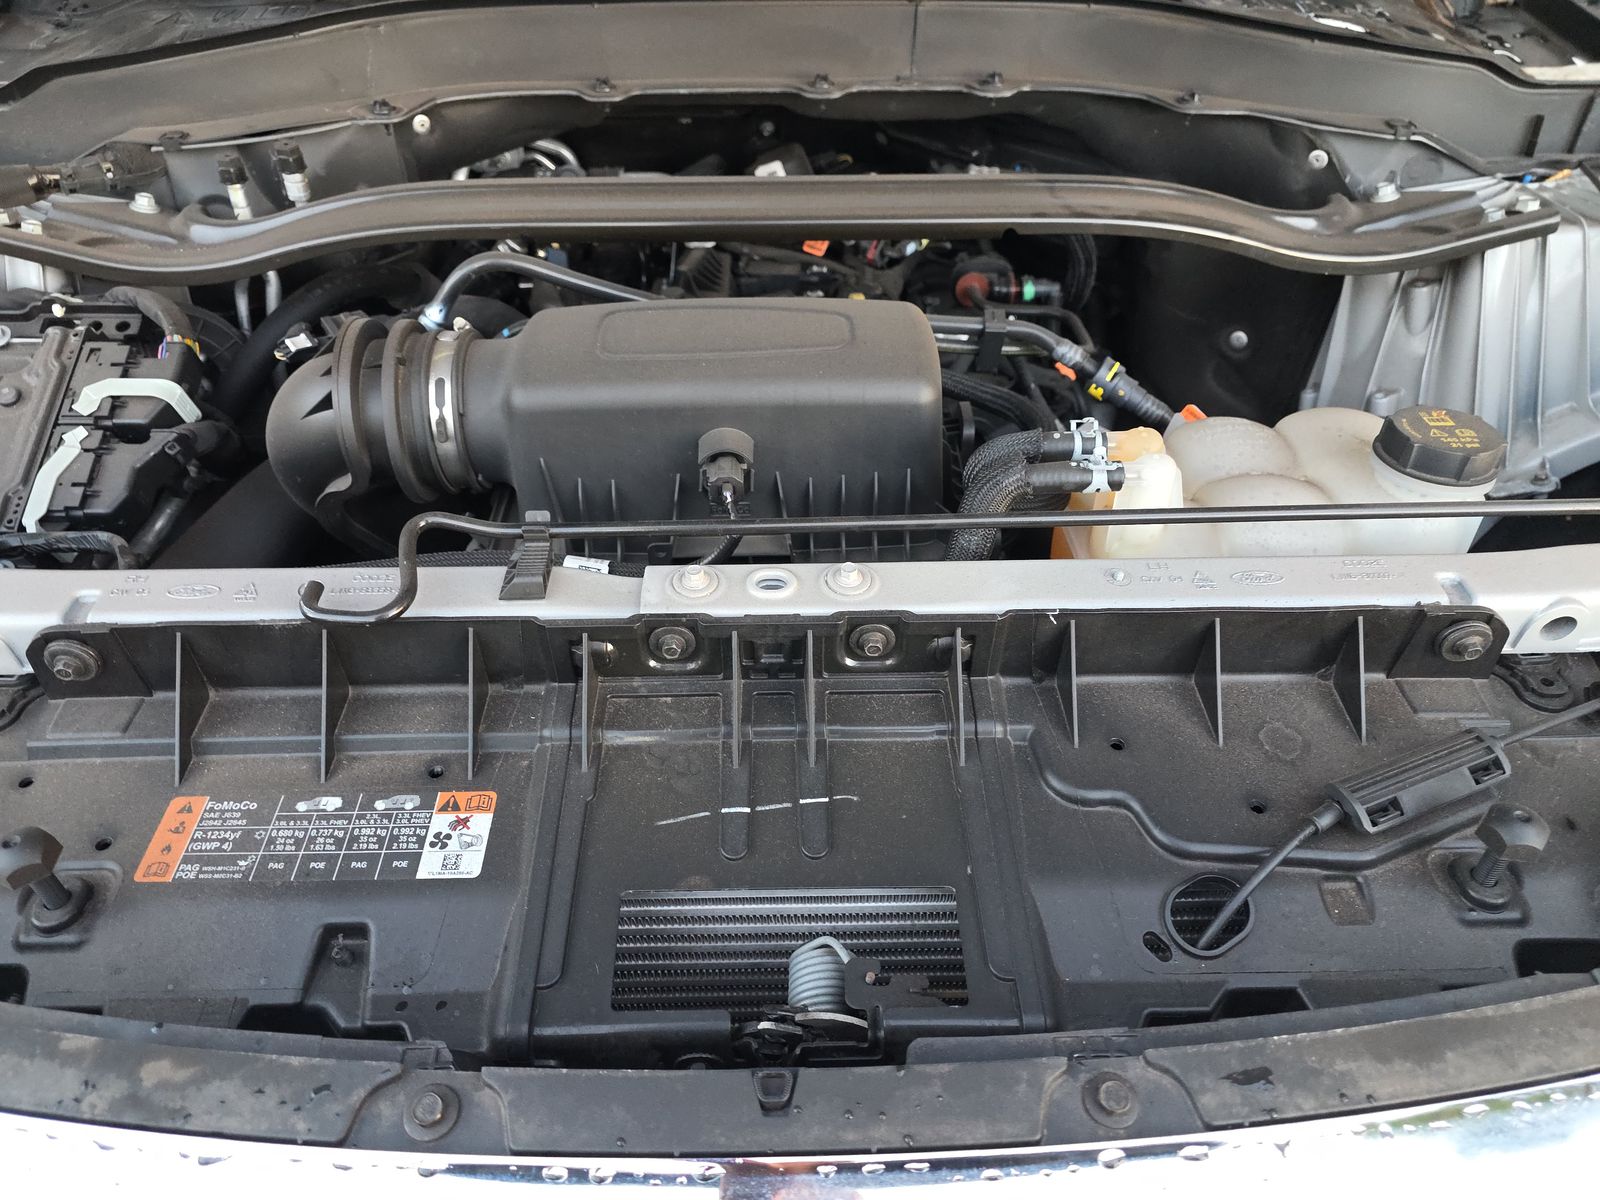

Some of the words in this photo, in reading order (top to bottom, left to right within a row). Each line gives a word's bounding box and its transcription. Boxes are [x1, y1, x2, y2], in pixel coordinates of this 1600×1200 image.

[206, 800, 258, 811] FoMoCo
[193, 830, 243, 840] R-1234yf
[294, 829, 305, 838] kg
[310, 829, 334, 837] 0.737
[334, 829, 344, 838] kg
[353, 828, 376, 836] 0.992
[376, 828, 387, 837] kg
[392, 828, 415, 836] 0.992
[416, 828, 427, 837] kg
[188, 842, 220, 852] (GWP
[221, 842, 233, 852] 4)
[178, 864, 200, 872] PAG
